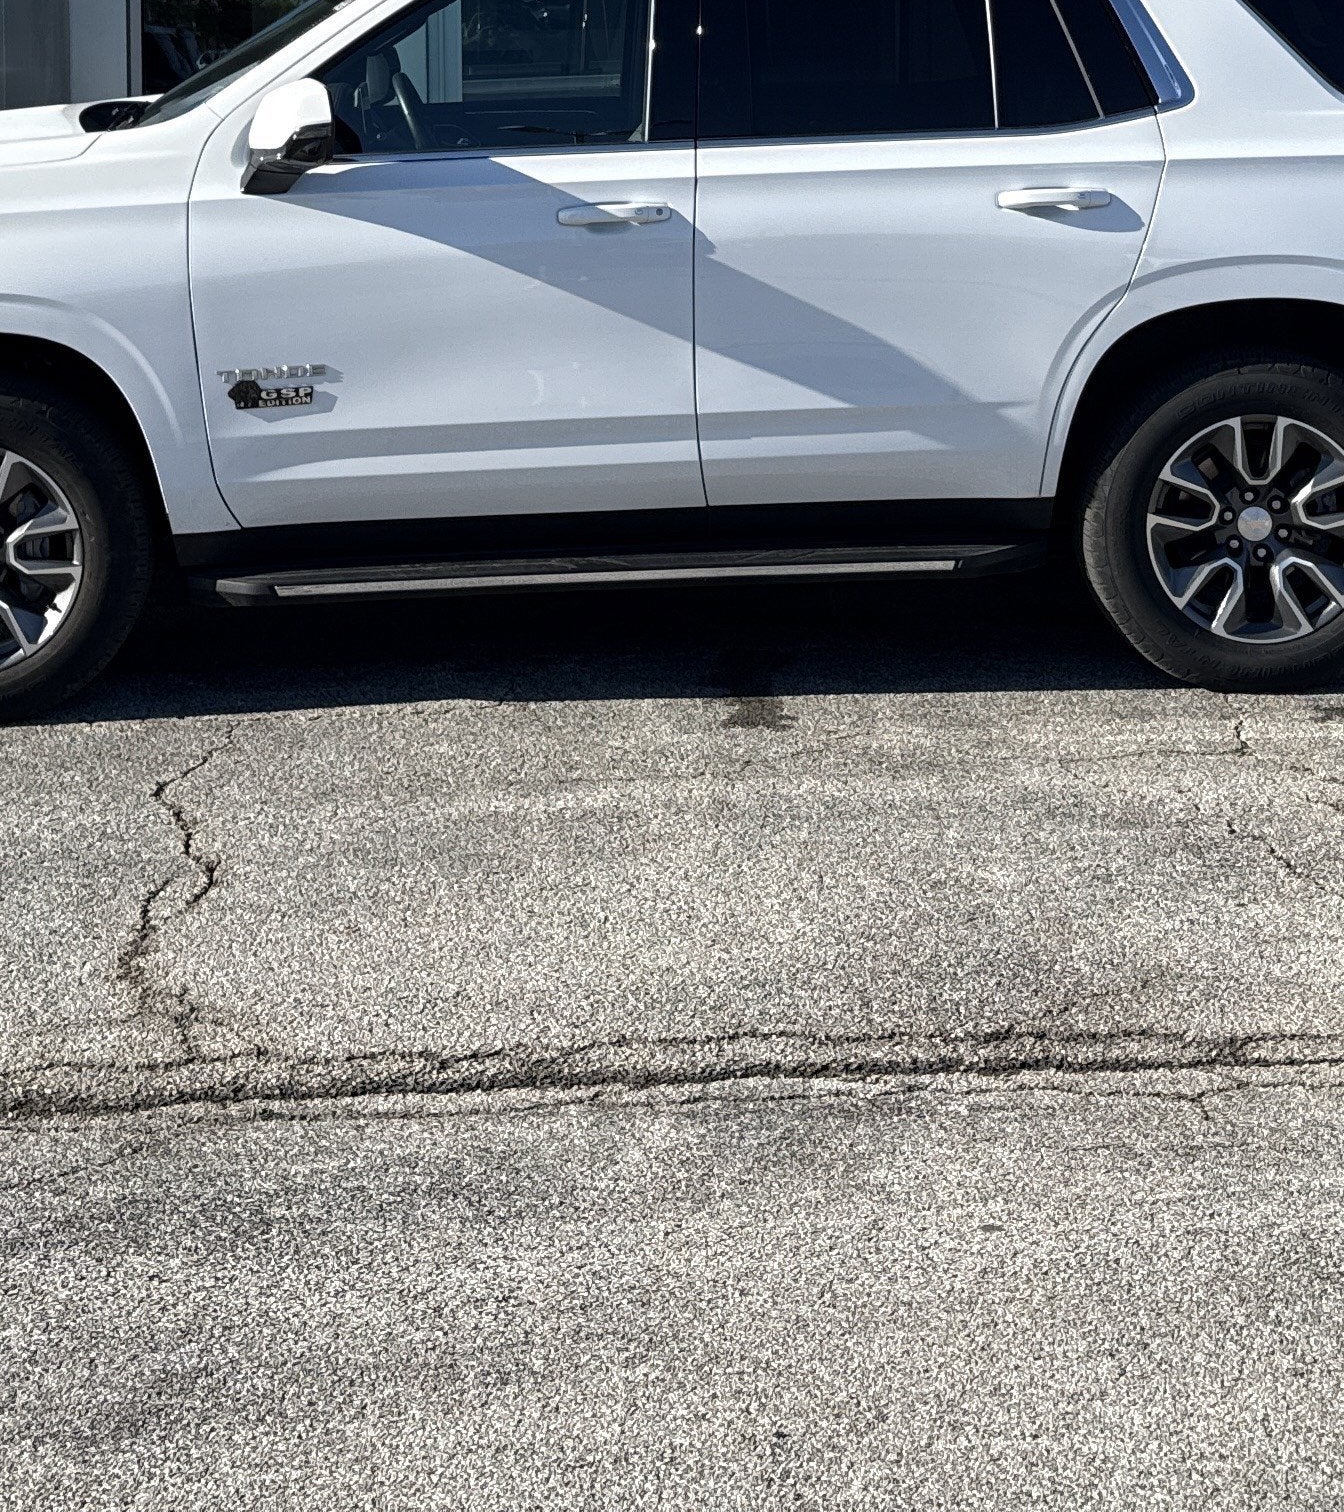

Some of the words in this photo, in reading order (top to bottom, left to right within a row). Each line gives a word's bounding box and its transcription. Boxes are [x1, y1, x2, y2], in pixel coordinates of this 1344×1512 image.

[216, 363, 326, 383] TAHOE
[260, 386, 312, 400] GSP
[258, 395, 312, 408] EDITION
